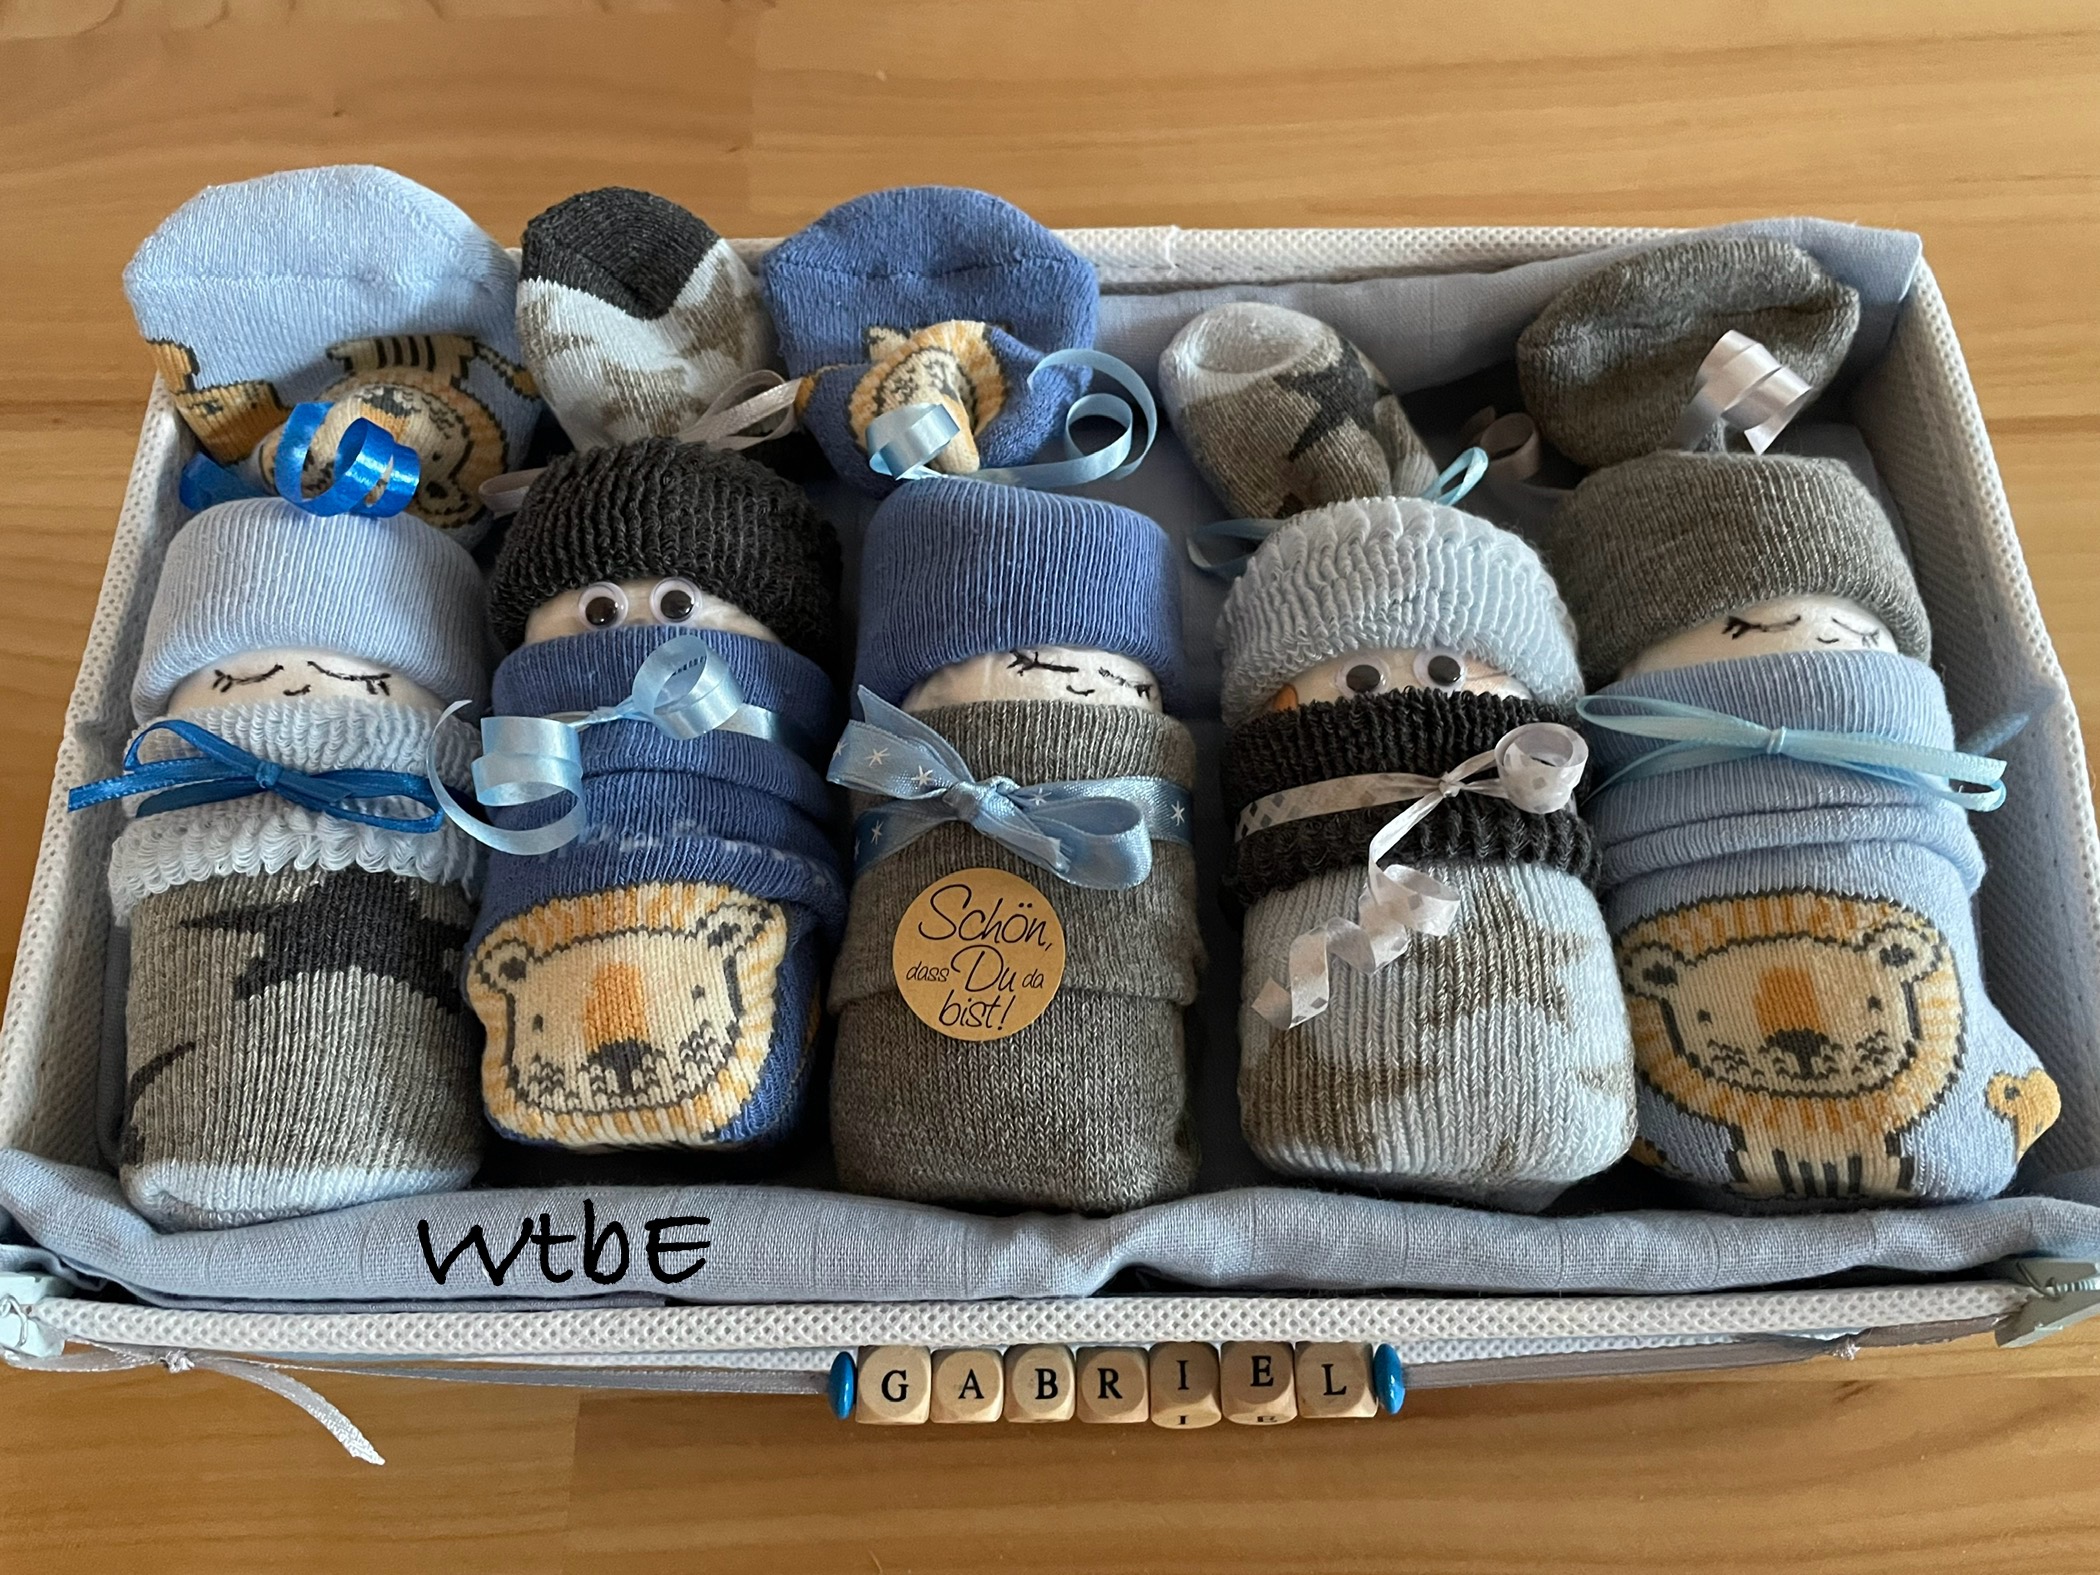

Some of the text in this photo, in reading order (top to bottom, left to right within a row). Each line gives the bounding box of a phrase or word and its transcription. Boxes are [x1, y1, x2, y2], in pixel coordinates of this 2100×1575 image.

[918, 884, 1053, 951] Schön,
[906, 944, 1045, 993] dass Du da
[938, 989, 1016, 1031] bist!
[880, 1355, 1347, 1403] GABRIEL
